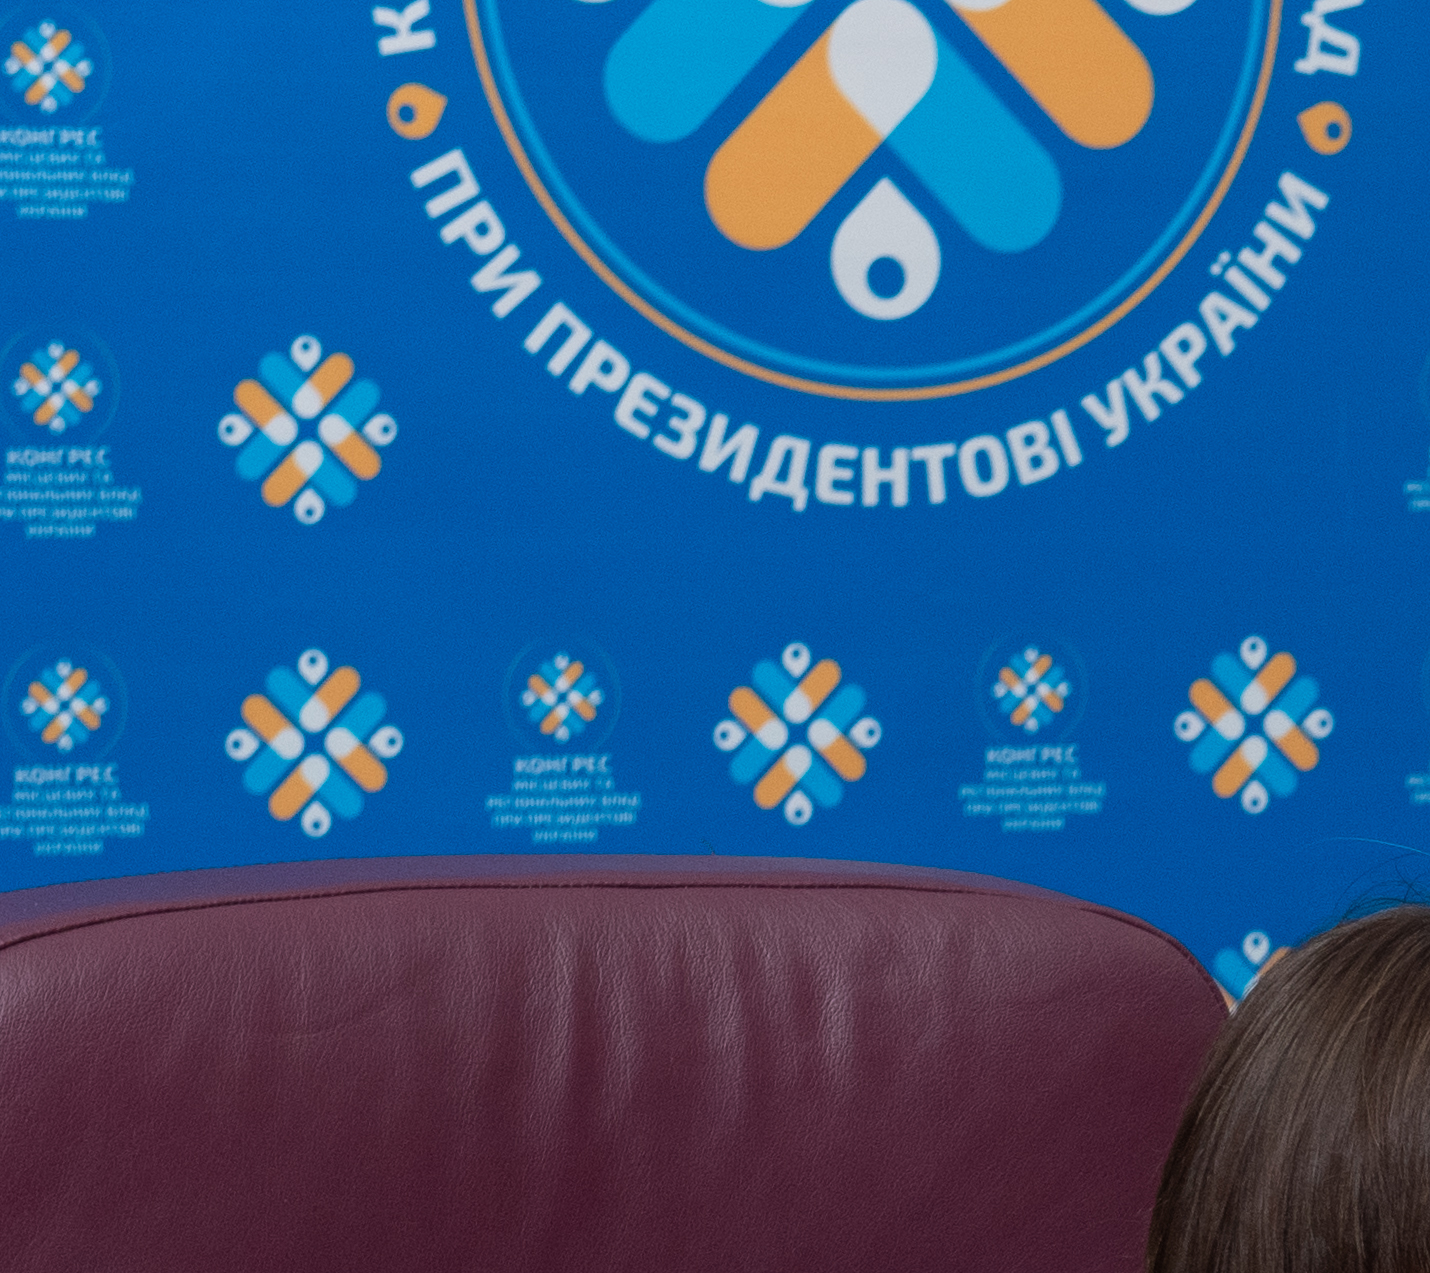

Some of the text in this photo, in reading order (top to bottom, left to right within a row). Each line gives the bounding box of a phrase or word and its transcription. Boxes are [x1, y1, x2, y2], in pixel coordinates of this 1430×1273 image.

[411, 148, 1330, 511] ПРИ ПРЕЗИДЕНТОВІ УКРАЇНИ
